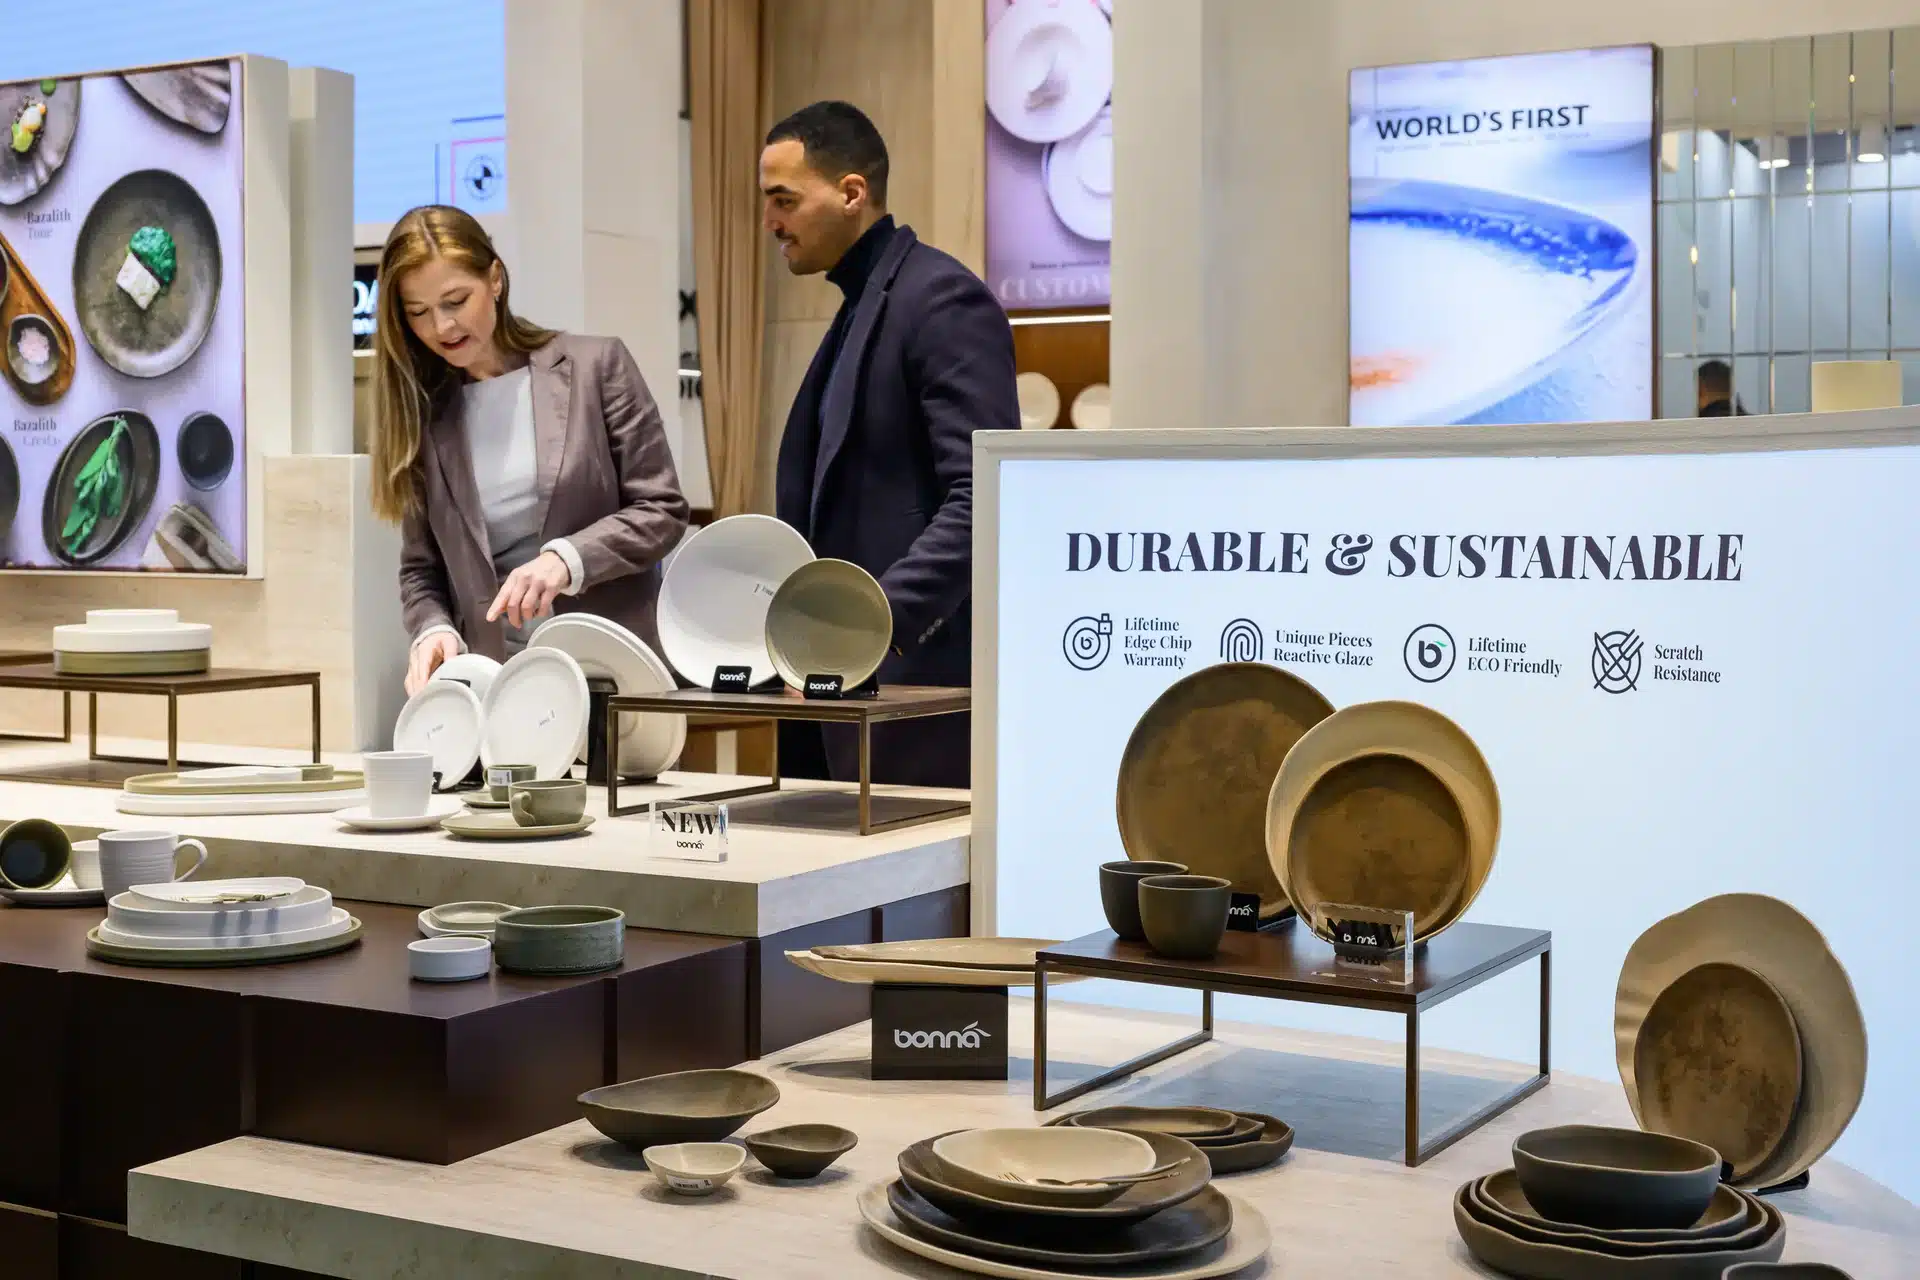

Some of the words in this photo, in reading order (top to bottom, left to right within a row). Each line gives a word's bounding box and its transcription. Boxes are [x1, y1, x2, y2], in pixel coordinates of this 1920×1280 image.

[1376, 111, 1502, 140] WORLD'S
[1512, 105, 1590, 130] FIRST
[1065, 531, 1309, 574] DURABLE
[1325, 533, 1373, 576] &
[1387, 534, 1744, 581] SUSTAINABLE
[1124, 617, 1180, 632] Lifetime
[1124, 635, 1157, 651] Edge
[1160, 635, 1192, 652] Chip
[1275, 629, 1325, 648] Unique
[1328, 632, 1373, 648] Pieces
[1468, 637, 1527, 654] Lifetime
[1124, 653, 1186, 670] Warranty
[1273, 647, 1332, 665] Reactive
[1335, 650, 1374, 667] Glaze
[1654, 644, 1704, 661] Scratch
[1468, 656, 1500, 672] ECO
[1503, 658, 1563, 678] Friendly
[1653, 664, 1721, 684] Resistance
[661, 810, 719, 835] NEW
